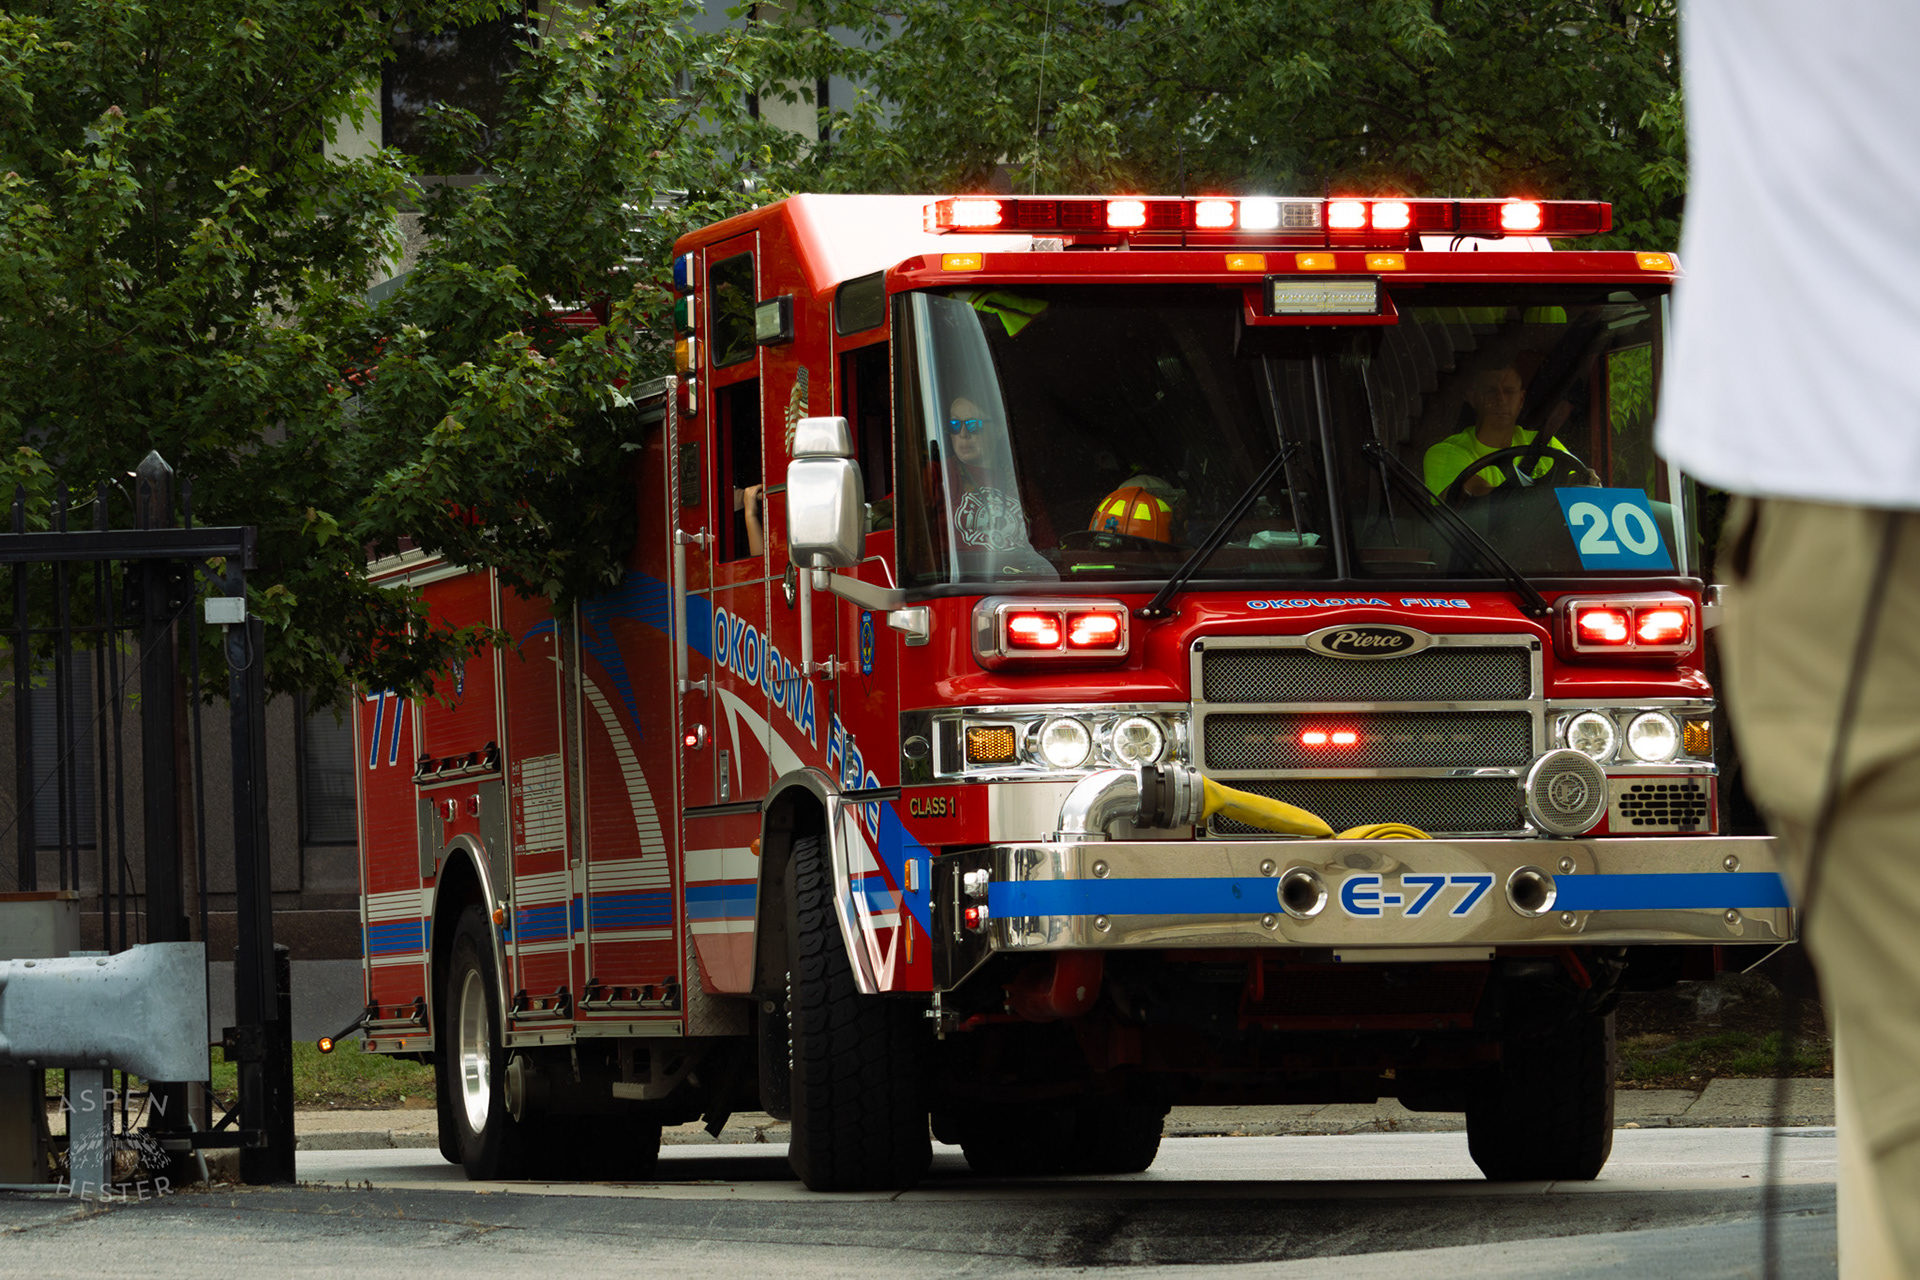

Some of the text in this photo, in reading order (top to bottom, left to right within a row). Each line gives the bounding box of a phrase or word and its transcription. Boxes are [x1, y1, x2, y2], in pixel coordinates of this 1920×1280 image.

[1568, 501, 1659, 556] 20
[1246, 598, 1471, 610] OKOLONA FIRE
[1331, 630, 1403, 650] Pierce
[715, 606, 817, 751] OKOLONA
[910, 795, 956, 818] CLASS 1
[1338, 872, 1496, 918] E-77
